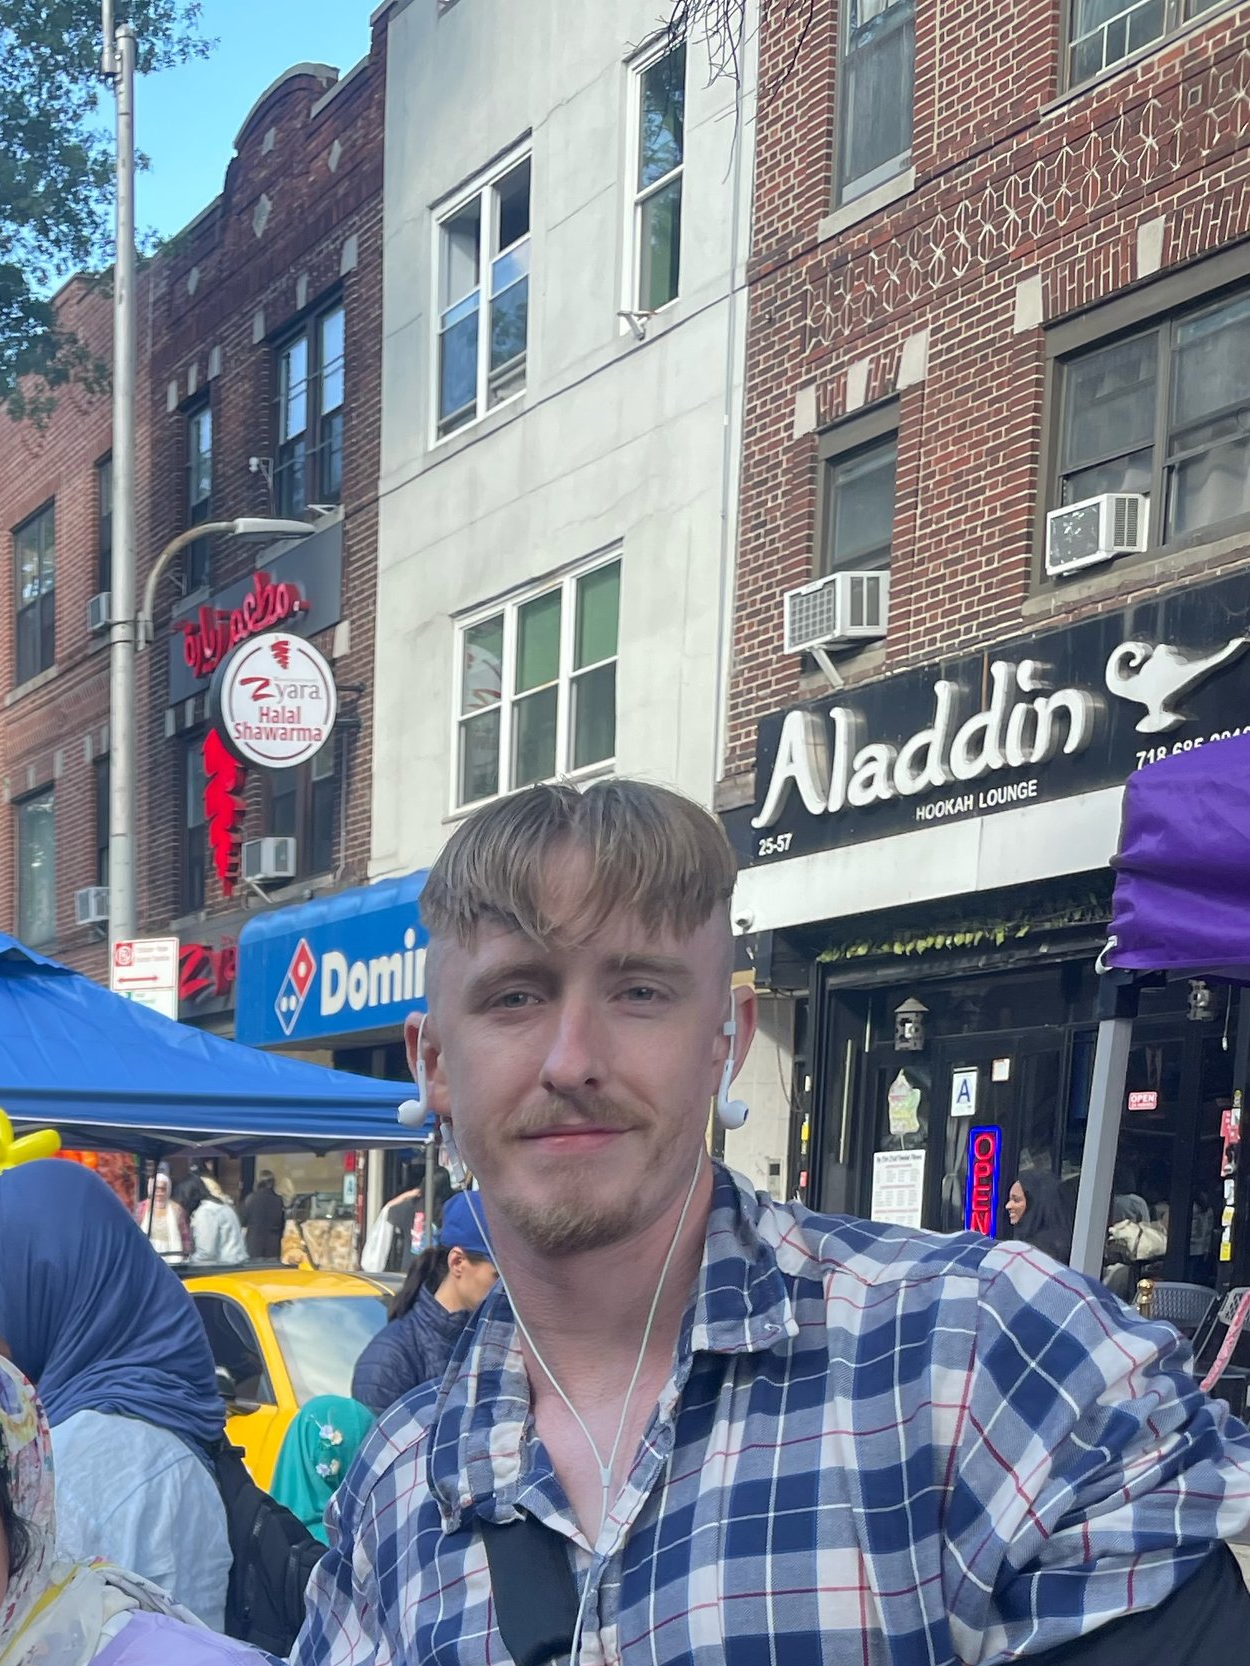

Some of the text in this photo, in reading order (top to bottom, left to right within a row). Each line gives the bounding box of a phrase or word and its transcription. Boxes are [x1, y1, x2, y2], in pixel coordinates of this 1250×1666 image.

[239, 676, 323, 704] Zyara
[259, 706, 302, 724] Halal
[234, 722, 323, 742] Shawarma
[751, 659, 1090, 829] Aladdin
[1135, 745, 1167, 771] 718
[916, 779, 1038, 822] HOOKAH LOUNGE
[758, 832, 793, 857] 25-57
[956, 1078, 971, 1104] A
[1130, 1093, 1155, 1103] OPEN
[970, 1133, 996, 1236] OPEN
